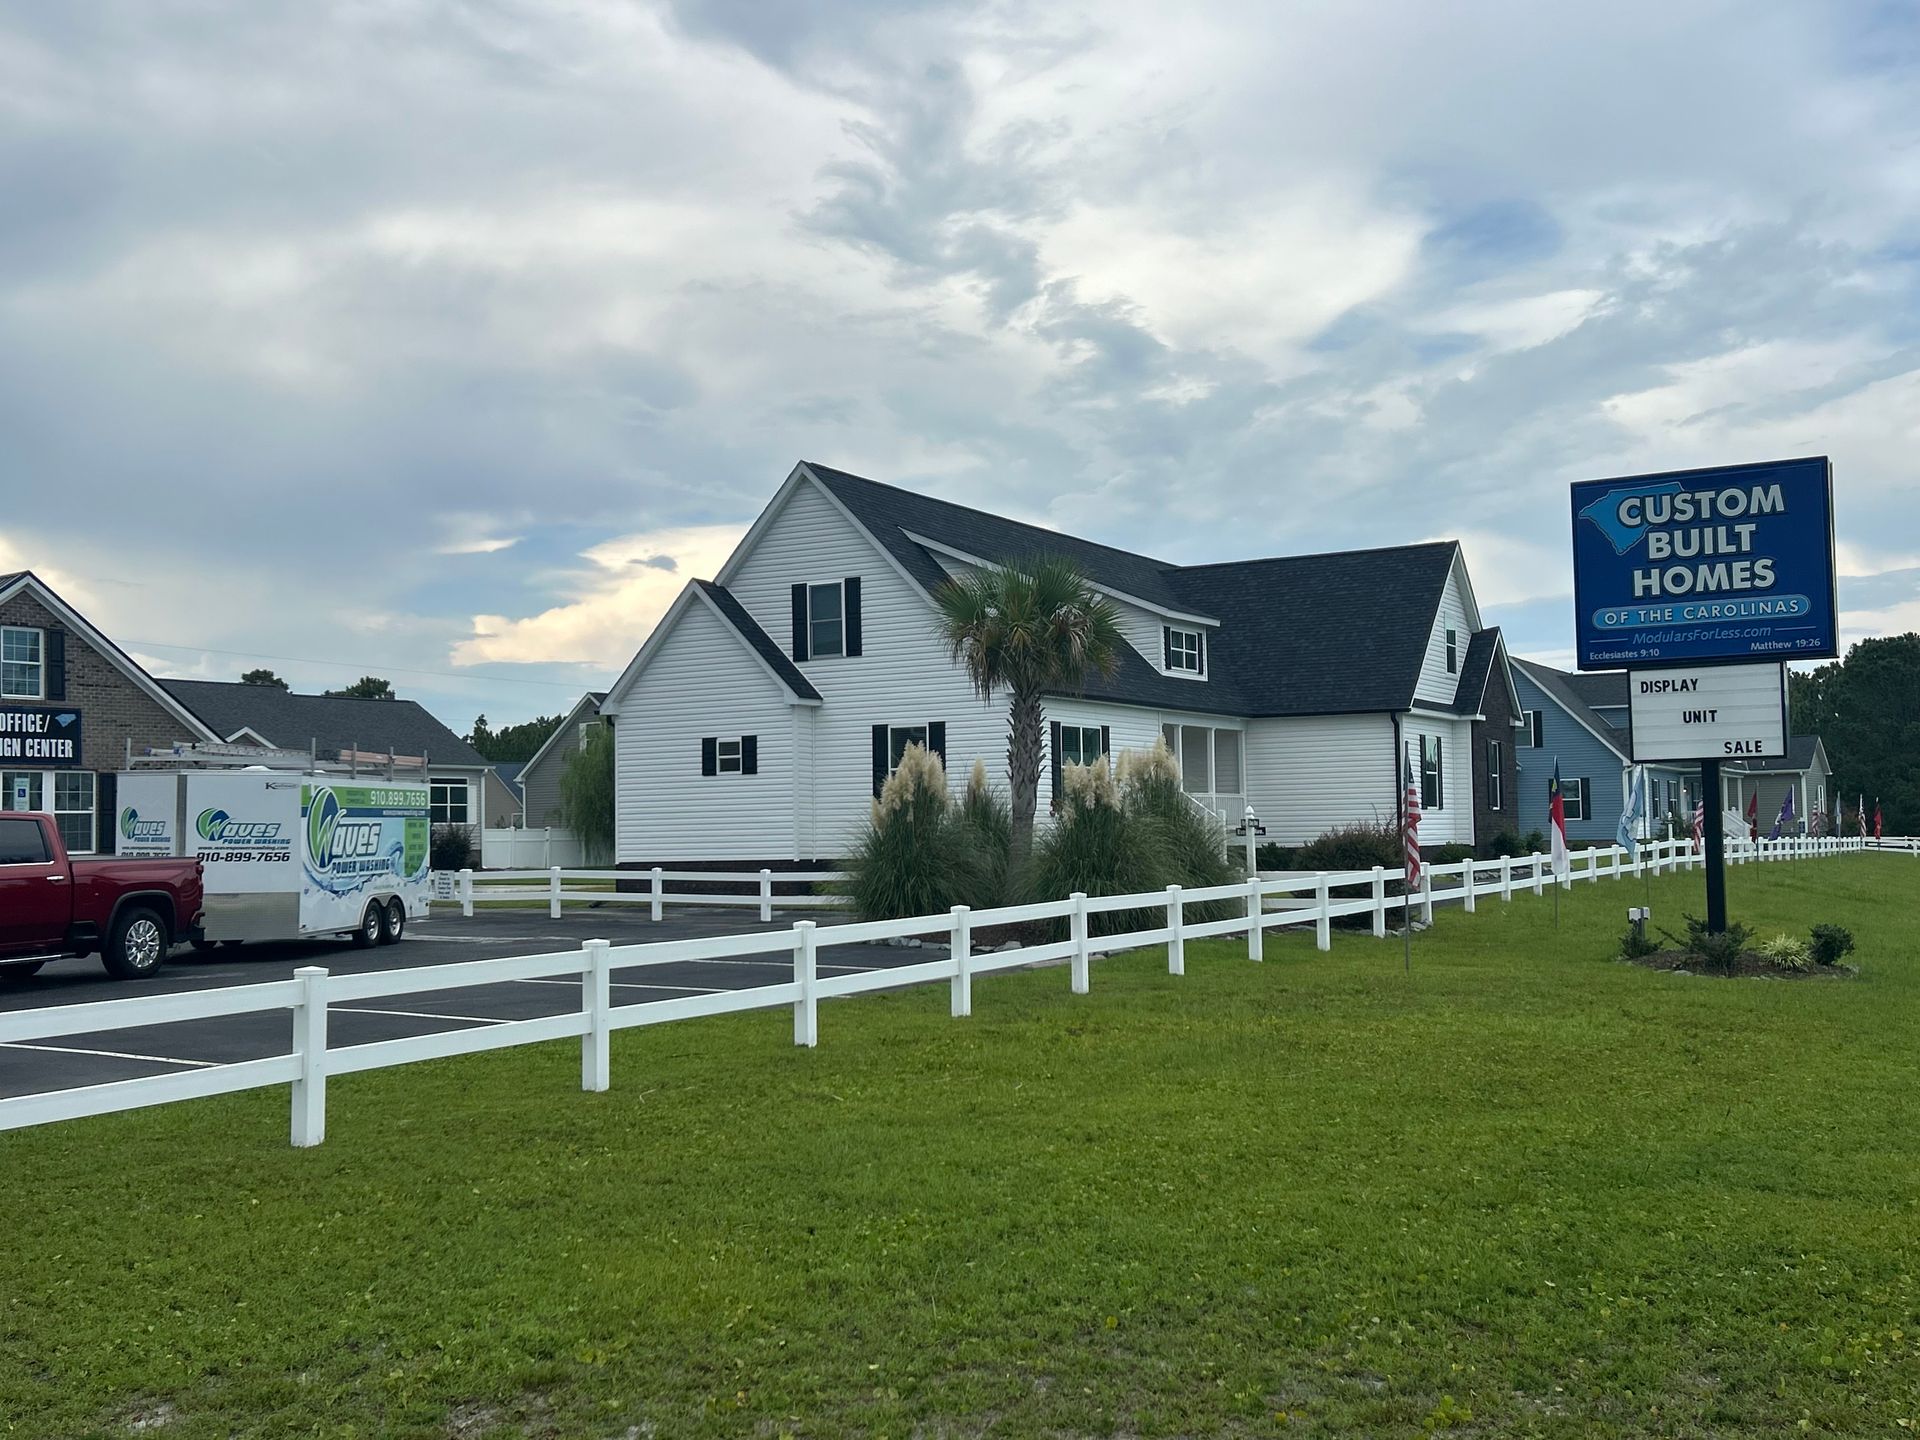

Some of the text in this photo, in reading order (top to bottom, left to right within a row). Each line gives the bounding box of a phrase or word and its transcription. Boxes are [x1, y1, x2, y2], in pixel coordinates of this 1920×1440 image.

[1618, 484, 1785, 526] CUSTOM
[1648, 523, 1757, 560] BUILT
[1633, 558, 1776, 597] HOMES
[1604, 600, 1799, 625] OF THE CAROLINAS
[1632, 626, 1772, 645] ModularsForLess.com
[1750, 637, 1821, 650] Matthew 19:26
[1589, 647, 1660, 660] Ecclesiastes 9:10
[1640, 678, 1699, 694] DISPLAY
[0, 712, 51, 733] OFFICE/
[1682, 709, 1718, 724] UNIT
[25, 738, 73, 758] CENTER
[1724, 740, 1763, 754] SALE
[370, 790, 426, 806] 910.899.7656
[196, 851, 291, 862] 910-899-7656
